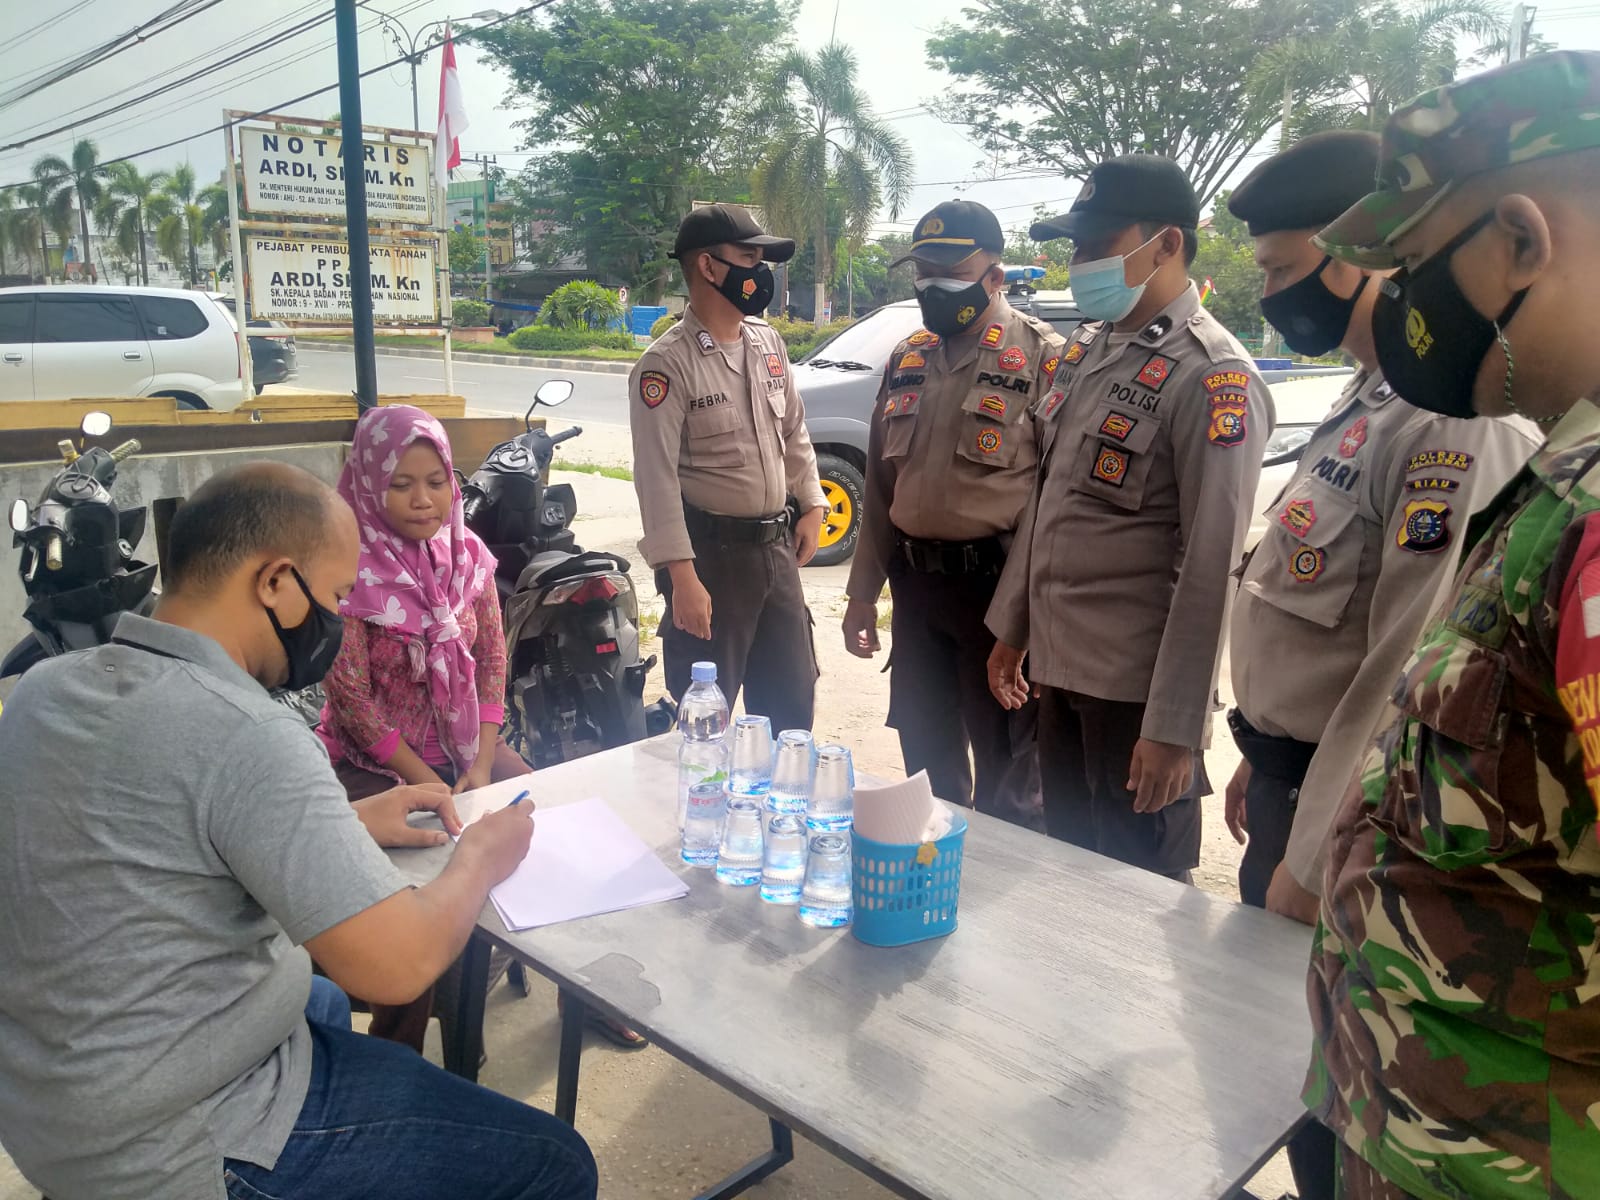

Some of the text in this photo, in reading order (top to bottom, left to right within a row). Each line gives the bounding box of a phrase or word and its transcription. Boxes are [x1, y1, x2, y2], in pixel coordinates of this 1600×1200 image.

[259, 159, 317, 182] ARDI,
[389, 172, 415, 187] Kn
[294, 185, 313, 193] HUKUM
[314, 186, 325, 195] DAN
[256, 241, 304, 252] PEJABAT
[311, 244, 350, 255] PEMBU
[394, 249, 427, 259] TANAH
[270, 271, 327, 290] ARDI,
[396, 275, 420, 290] Kn
[271, 298, 298, 307] NOMOR
[284, 288, 311, 298] KEPALA
[313, 289, 337, 299] BADAN
[388, 292, 420, 301] NASIONAL
[976, 371, 1031, 395] POLRI
[690, 392, 728, 411] FEBRA
[1107, 383, 1162, 413] POLISI
[1214, 394, 1245, 403] RIAU
[1311, 455, 1360, 491] POLRI
[1414, 479, 1450, 489] RIAU
